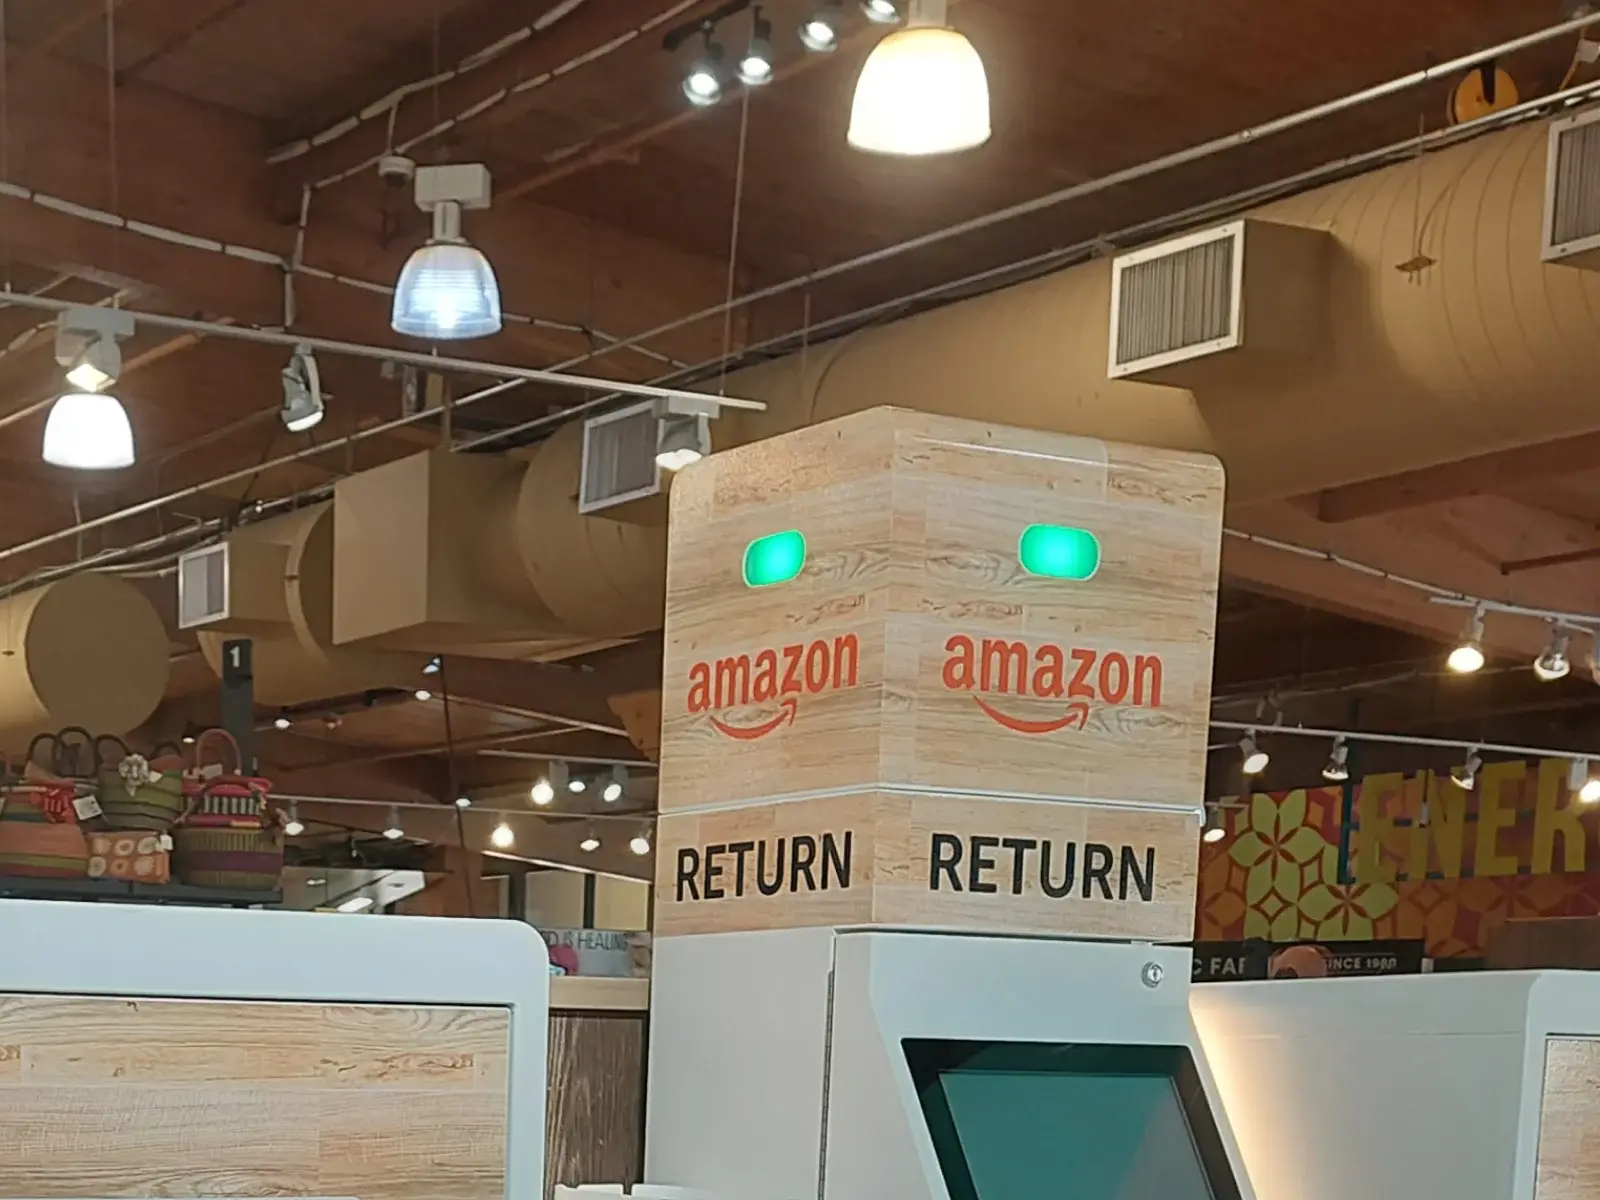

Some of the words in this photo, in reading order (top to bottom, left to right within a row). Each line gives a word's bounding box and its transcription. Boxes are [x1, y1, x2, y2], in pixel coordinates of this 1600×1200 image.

[229, 646, 240, 668] 1
[686, 633, 859, 714] amazon
[941, 633, 1163, 709] amazon
[675, 831, 853, 903] RETURN
[929, 833, 1156, 903] RETURN
